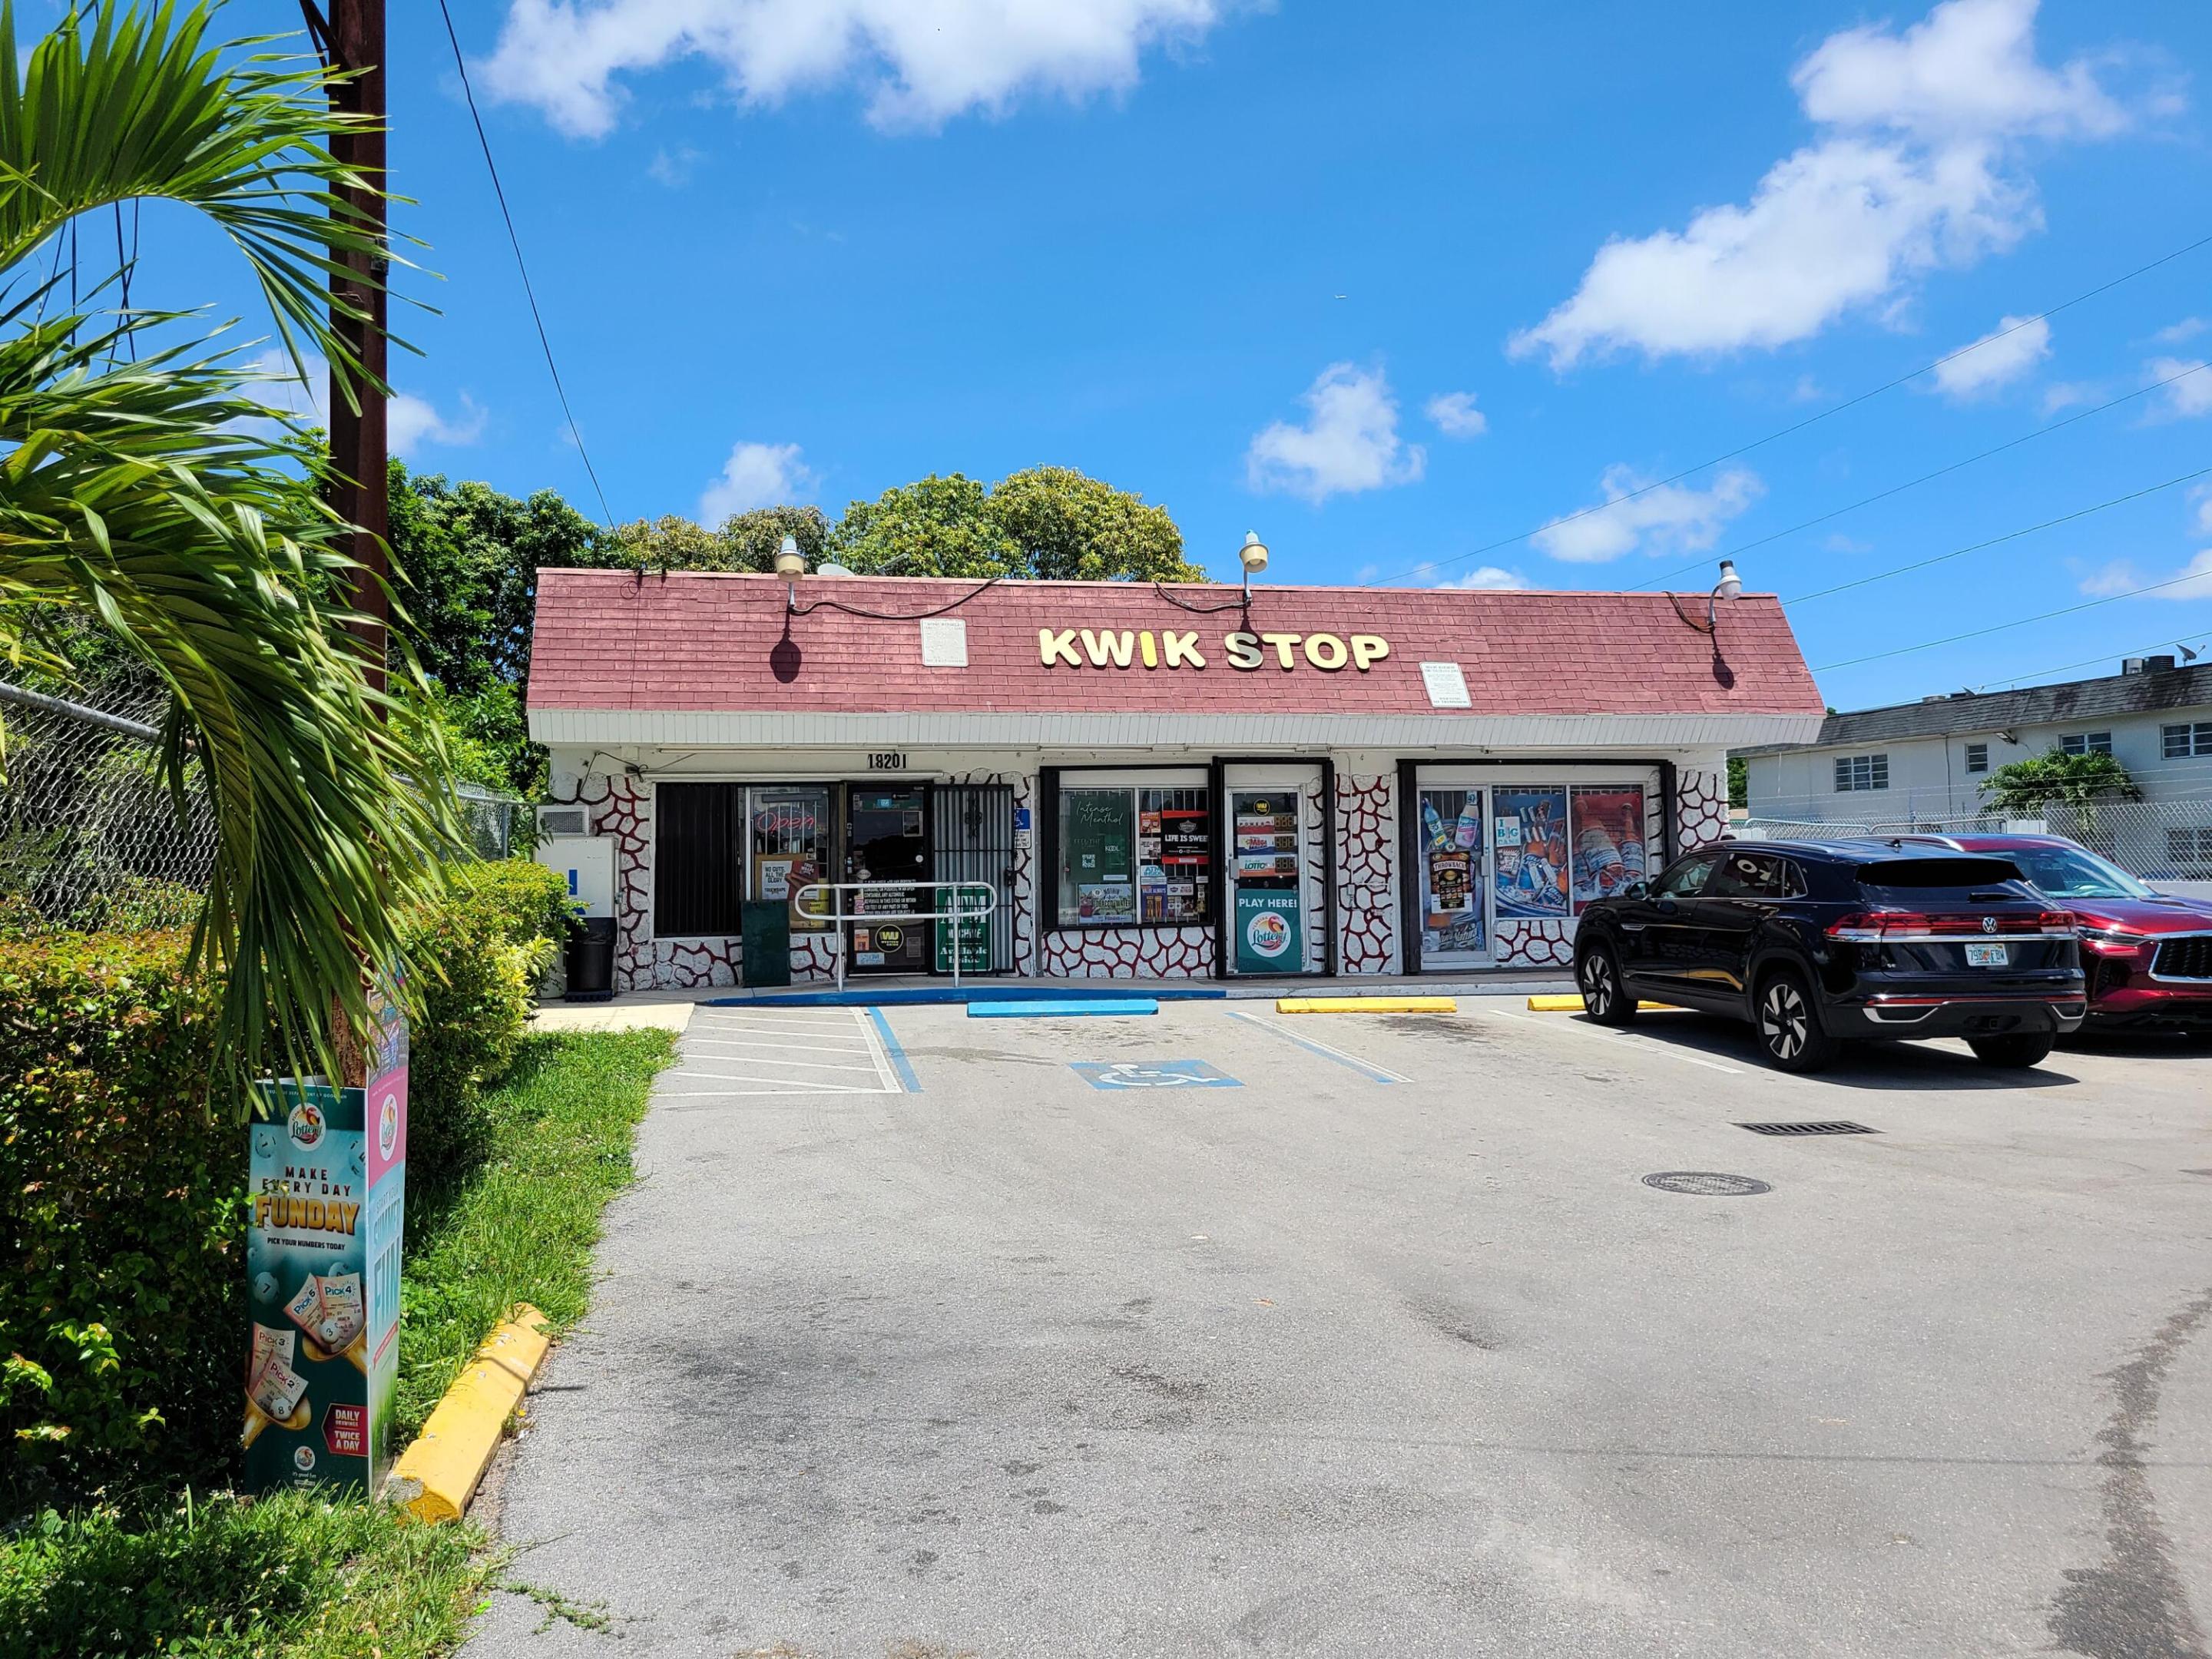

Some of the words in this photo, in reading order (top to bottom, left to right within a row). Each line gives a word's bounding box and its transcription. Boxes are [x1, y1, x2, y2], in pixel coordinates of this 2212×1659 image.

[1038, 628, 1207, 669] KWIK
[1224, 631, 1390, 672] STOP
[867, 753, 906, 769] 18201
[1077, 801, 1113, 816] Intense
[757, 812, 815, 834] Open
[1081, 811, 1124, 827] Menthol
[1435, 861, 1465, 870] THROWBACK
[1239, 898, 1265, 907] PLAY
[1267, 899, 1297, 908] HERE!
[940, 896, 987, 924] ATM
[948, 929, 982, 938] MCHINE
[1252, 929, 1288, 947] Lottery
[291, 1121, 323, 1144] Lottery
[285, 1166, 328, 1181] MAKE
[322, 1183, 351, 1197] DAY
[256, 1195, 360, 1236] FUNDAY
[298, 1240, 325, 1249] NUMBERS
[263, 1283, 271, 1293] 7
[309, 1289, 316, 1297] 5
[345, 1285, 352, 1293] 4
[326, 1328, 333, 1337] 3
[287, 1379, 295, 1388] 2
[278, 1406, 285, 1415] 8
[335, 1409, 360, 1421] DAILY
[334, 1430, 360, 1440] TWICE
[336, 1440, 342, 1449] A
[343, 1440, 360, 1450] DAY
